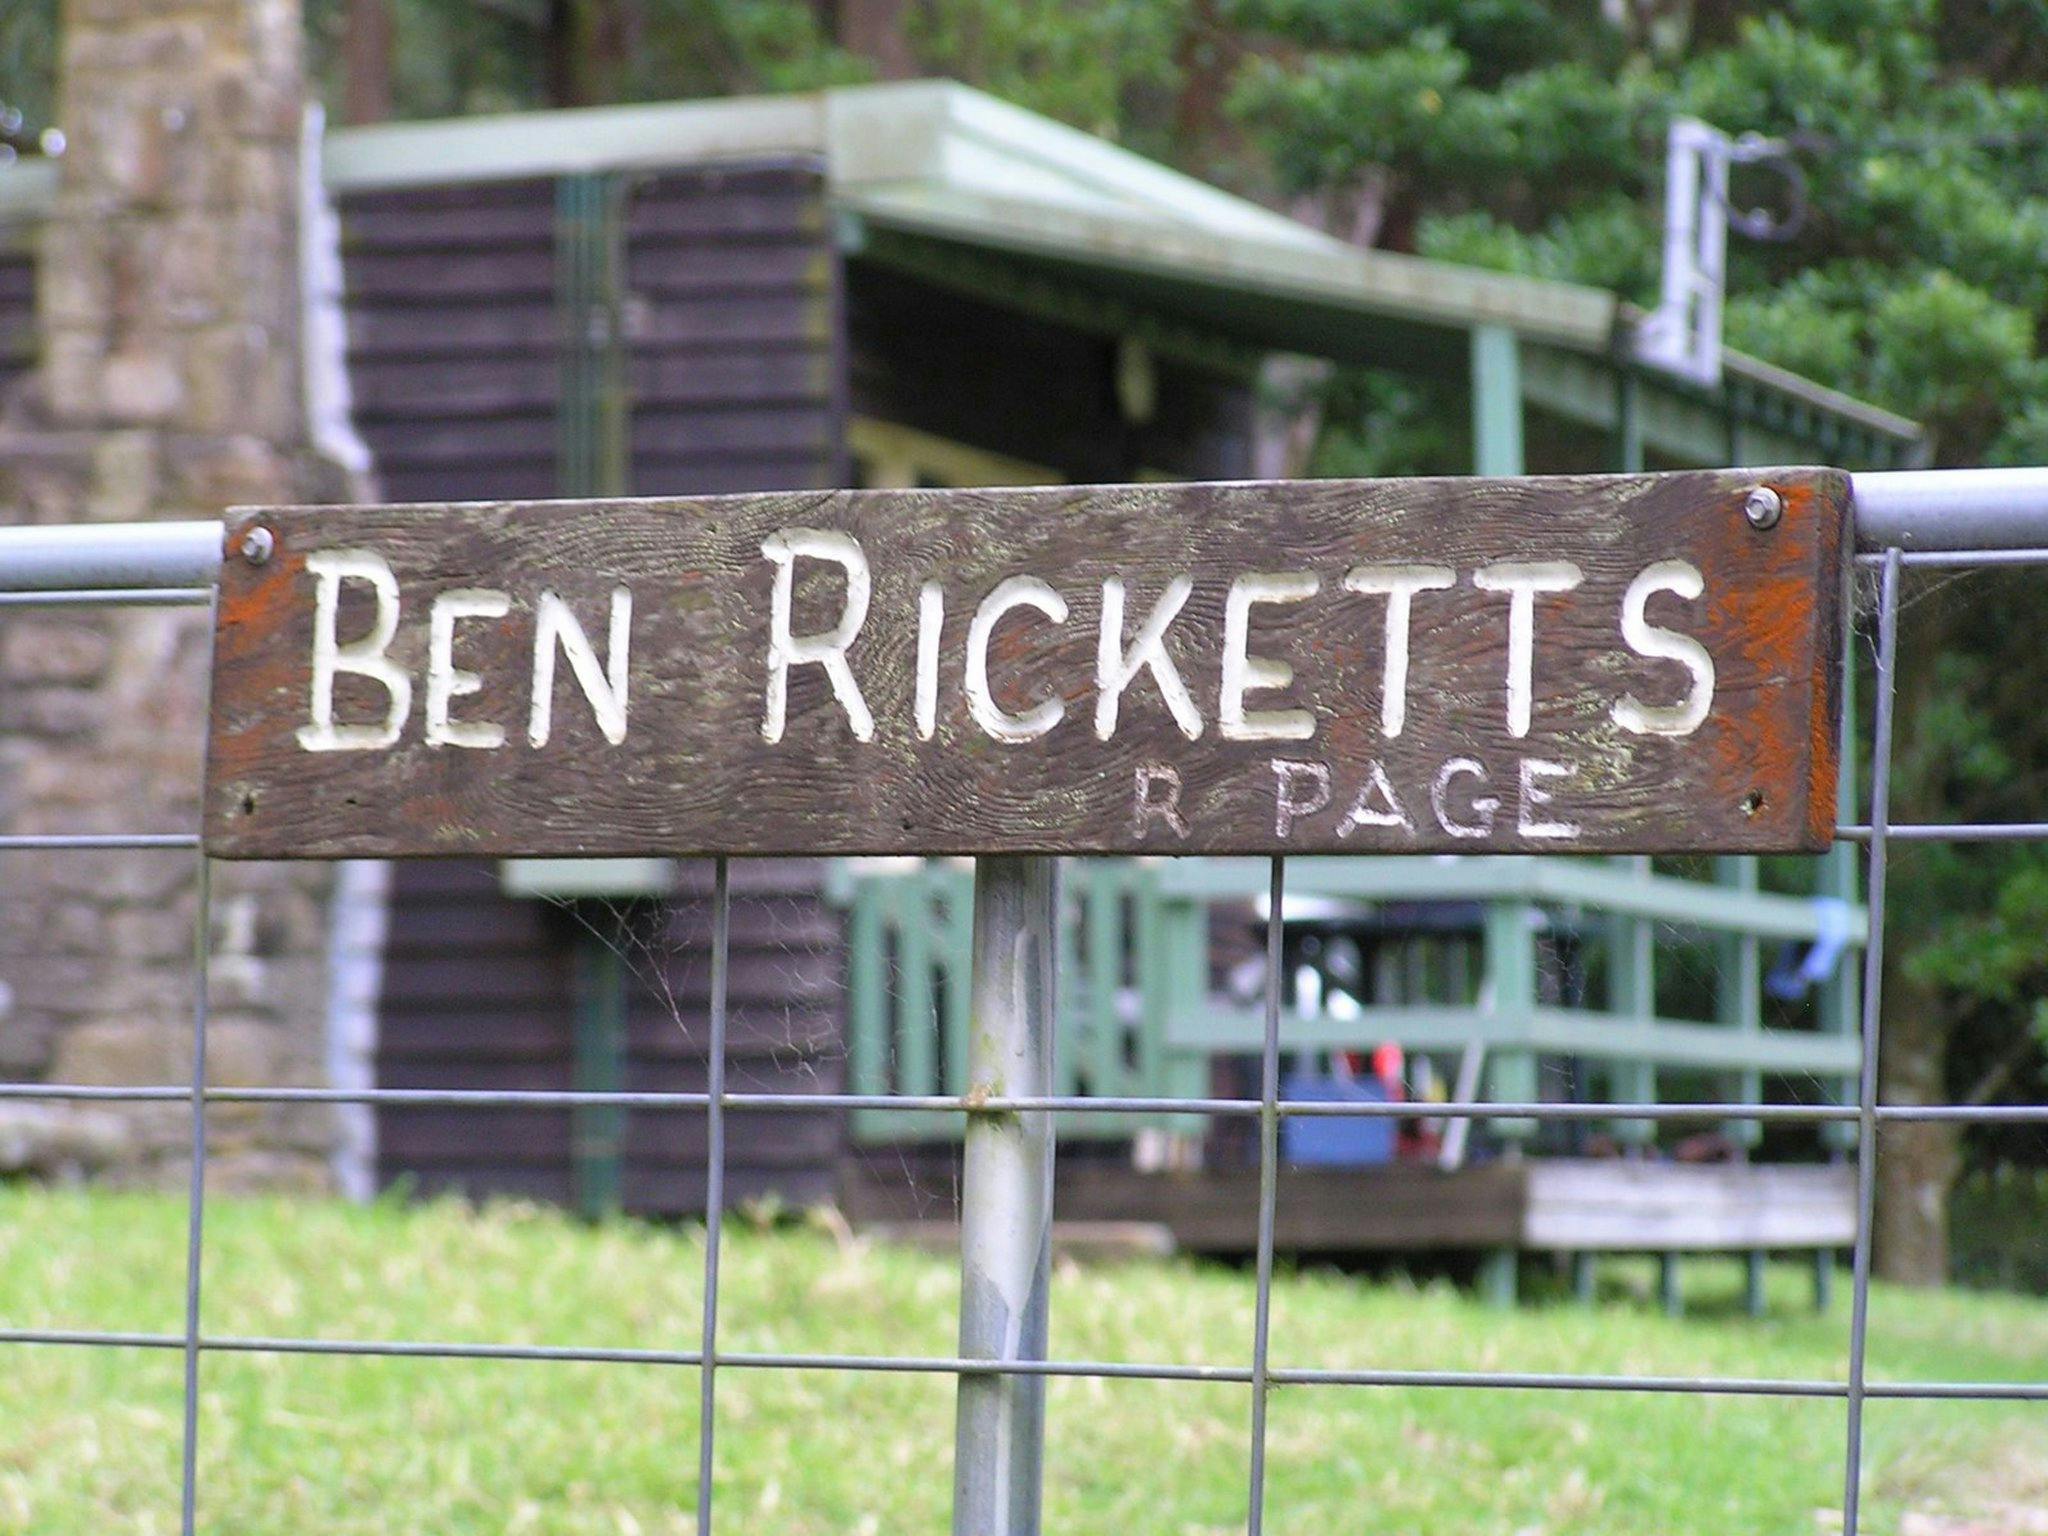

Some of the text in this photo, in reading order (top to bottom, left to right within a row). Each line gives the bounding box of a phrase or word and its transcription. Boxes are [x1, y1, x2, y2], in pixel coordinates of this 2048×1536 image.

[298, 527, 1716, 751] BEN RICKETTS
[1132, 757, 1581, 840] R PAGE
